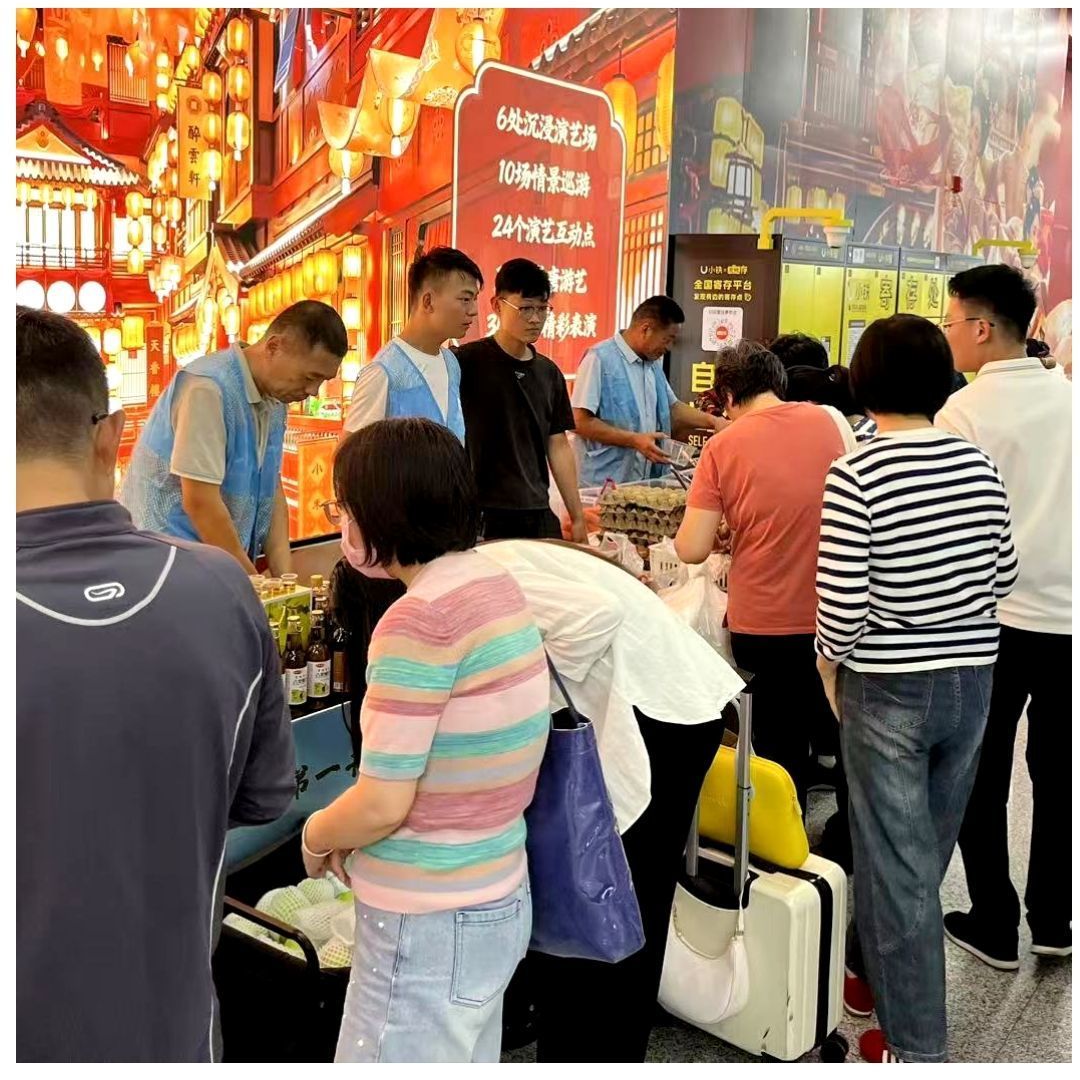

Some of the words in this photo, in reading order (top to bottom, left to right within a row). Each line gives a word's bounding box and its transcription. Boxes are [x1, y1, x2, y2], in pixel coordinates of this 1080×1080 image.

[496, 104, 599, 152] 6处沉浸演艺场
[497, 158, 591, 198] 10场情景巡游
[491, 213, 596, 249] 24个演艺互动点
[540, 266, 588, 294] 唐游艺
[693, 279, 752, 291] 全国寄存平台
[691, 361, 716, 393] 自
